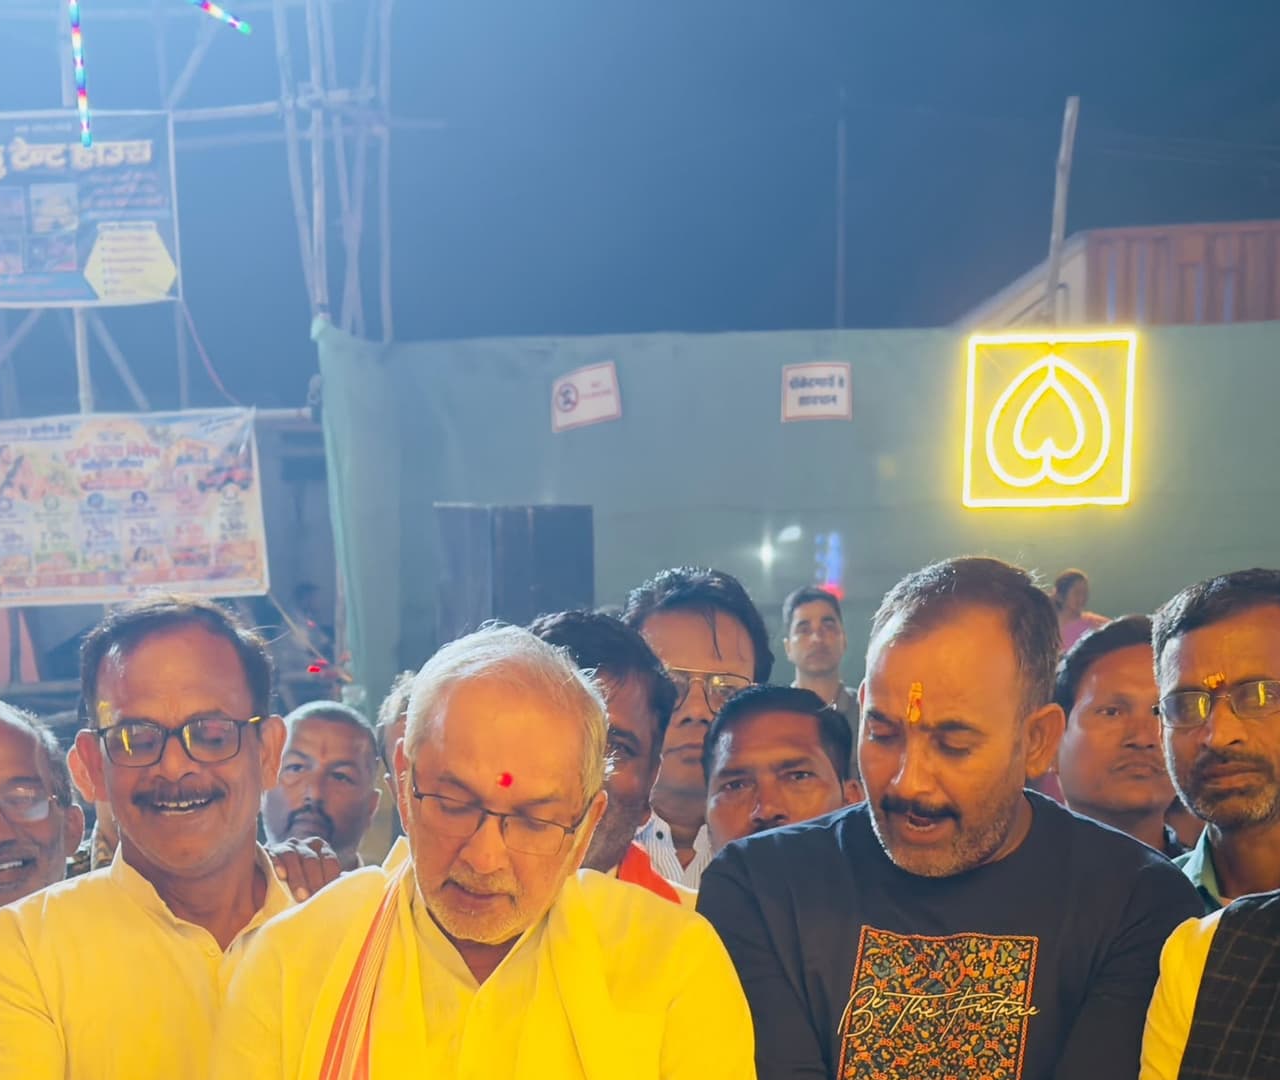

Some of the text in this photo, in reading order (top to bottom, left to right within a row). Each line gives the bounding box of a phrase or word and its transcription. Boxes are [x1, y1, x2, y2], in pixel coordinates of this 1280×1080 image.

[837, 985, 1041, 1043] Be The Future
